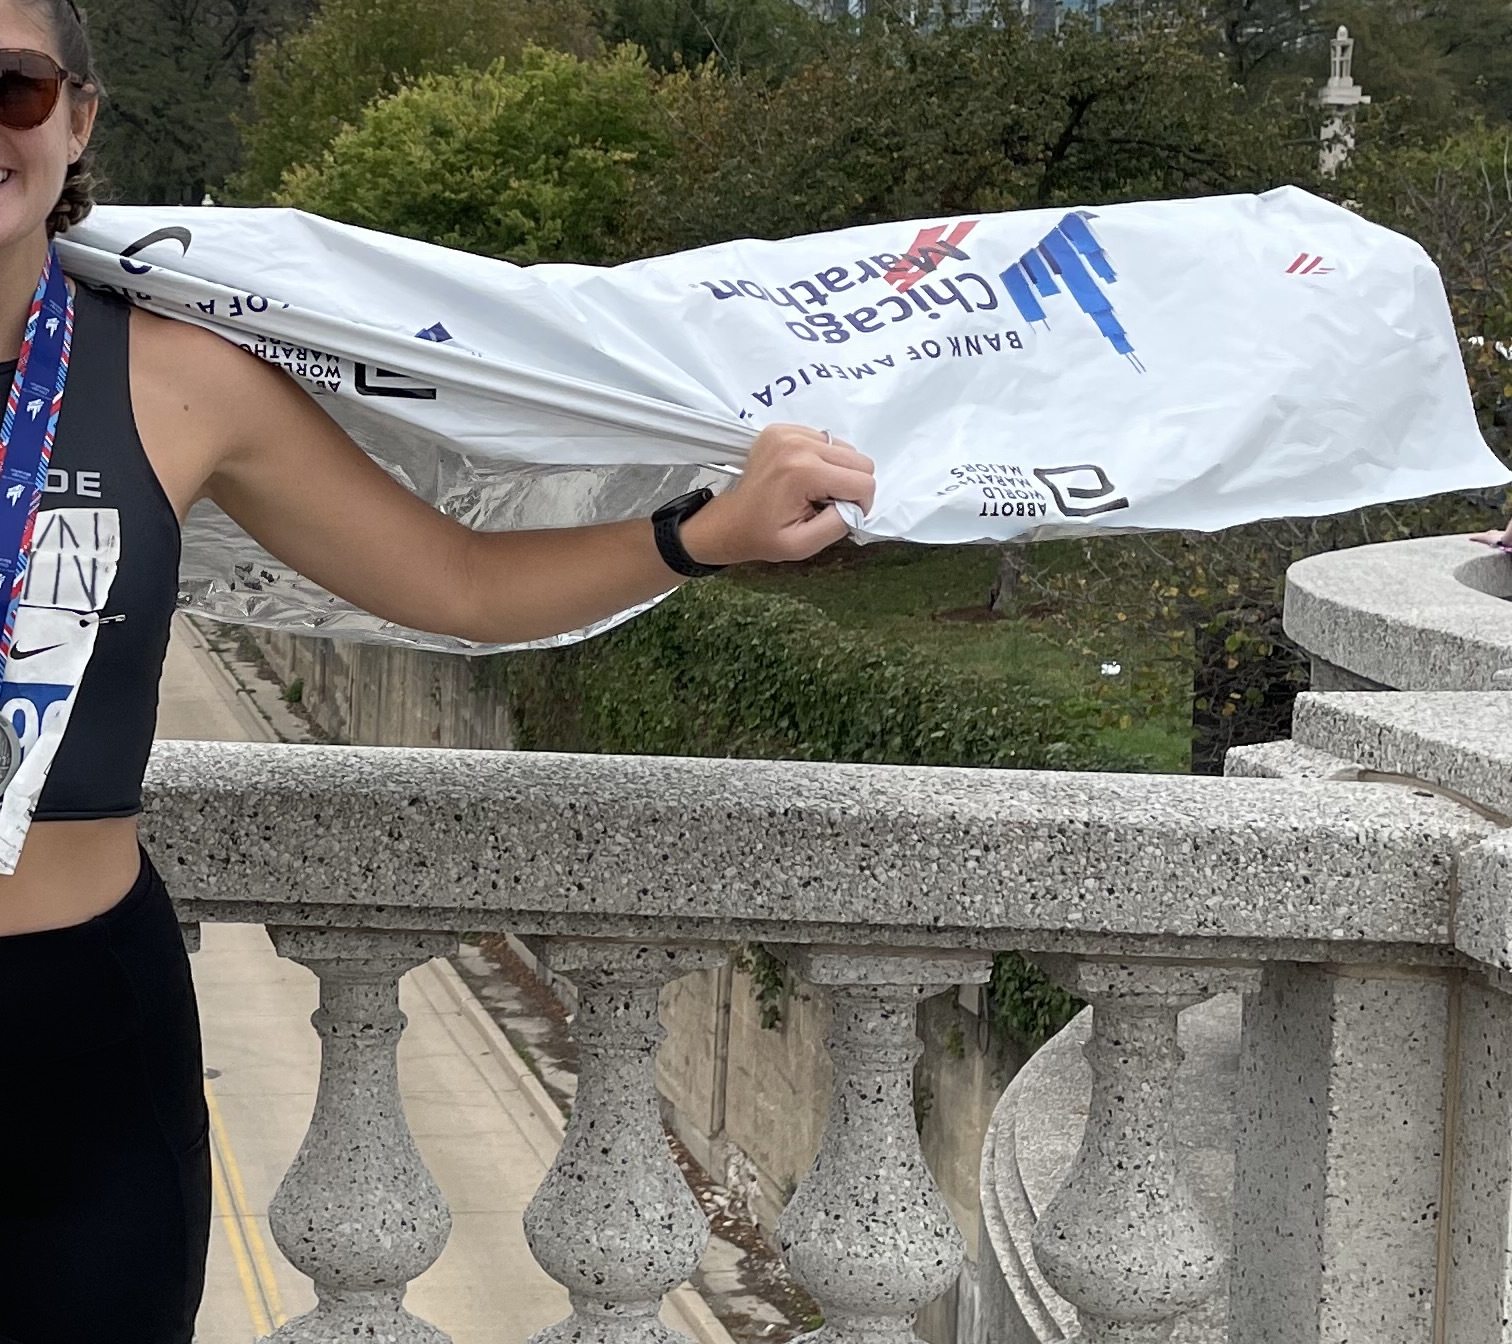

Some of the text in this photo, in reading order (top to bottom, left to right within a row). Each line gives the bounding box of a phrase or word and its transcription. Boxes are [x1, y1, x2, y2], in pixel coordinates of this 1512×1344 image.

[700, 240, 971, 314] Marathon
[785, 272, 999, 344] Chicago
[271, 362, 342, 379] WORL
[751, 330, 1024, 407] BANK OF AMERICA
[950, 463, 1023, 479] MAJORS
[982, 486, 1046, 500] WORLD
[979, 501, 1047, 517] ABBOTT
